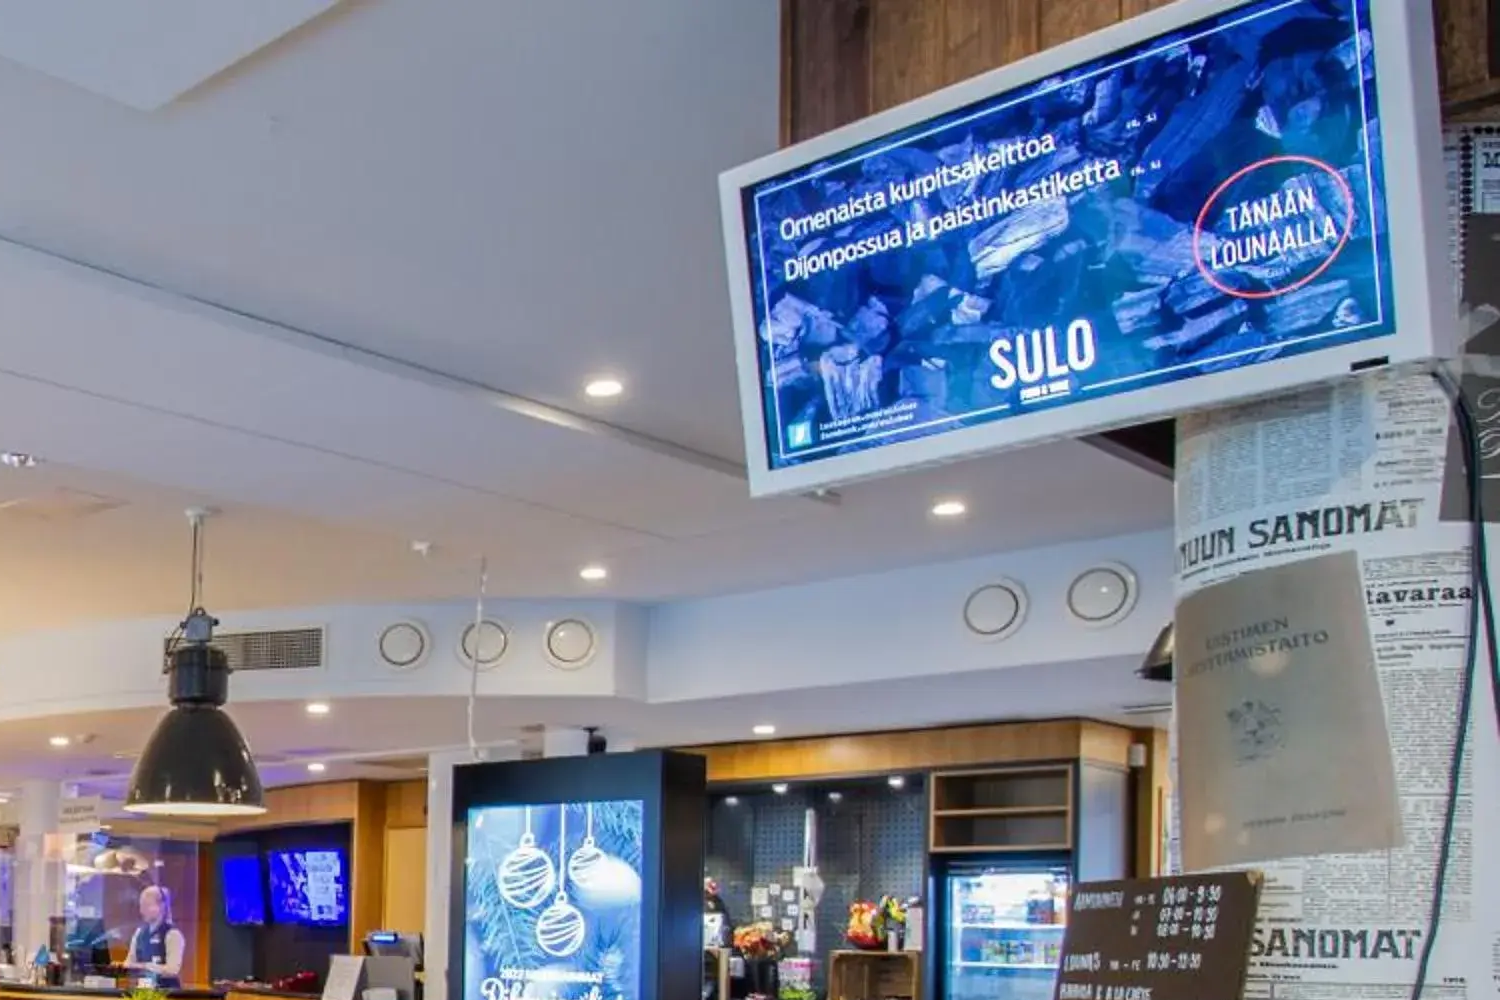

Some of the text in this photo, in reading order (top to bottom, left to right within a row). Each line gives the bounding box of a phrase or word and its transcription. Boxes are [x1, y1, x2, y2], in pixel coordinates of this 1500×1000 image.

[780, 133, 1056, 241] Omenaista kurpitsakeittoa
[1226, 186, 1315, 232] TÄNÄÄN
[784, 157, 1121, 281] Dijonpossua ja paistinkastiketta
[1211, 215, 1337, 270] LOUNAALLA
[989, 319, 1095, 389] SULO
[1248, 498, 1425, 548] SANOMAT
[1251, 928, 1421, 959] SANOMAT
